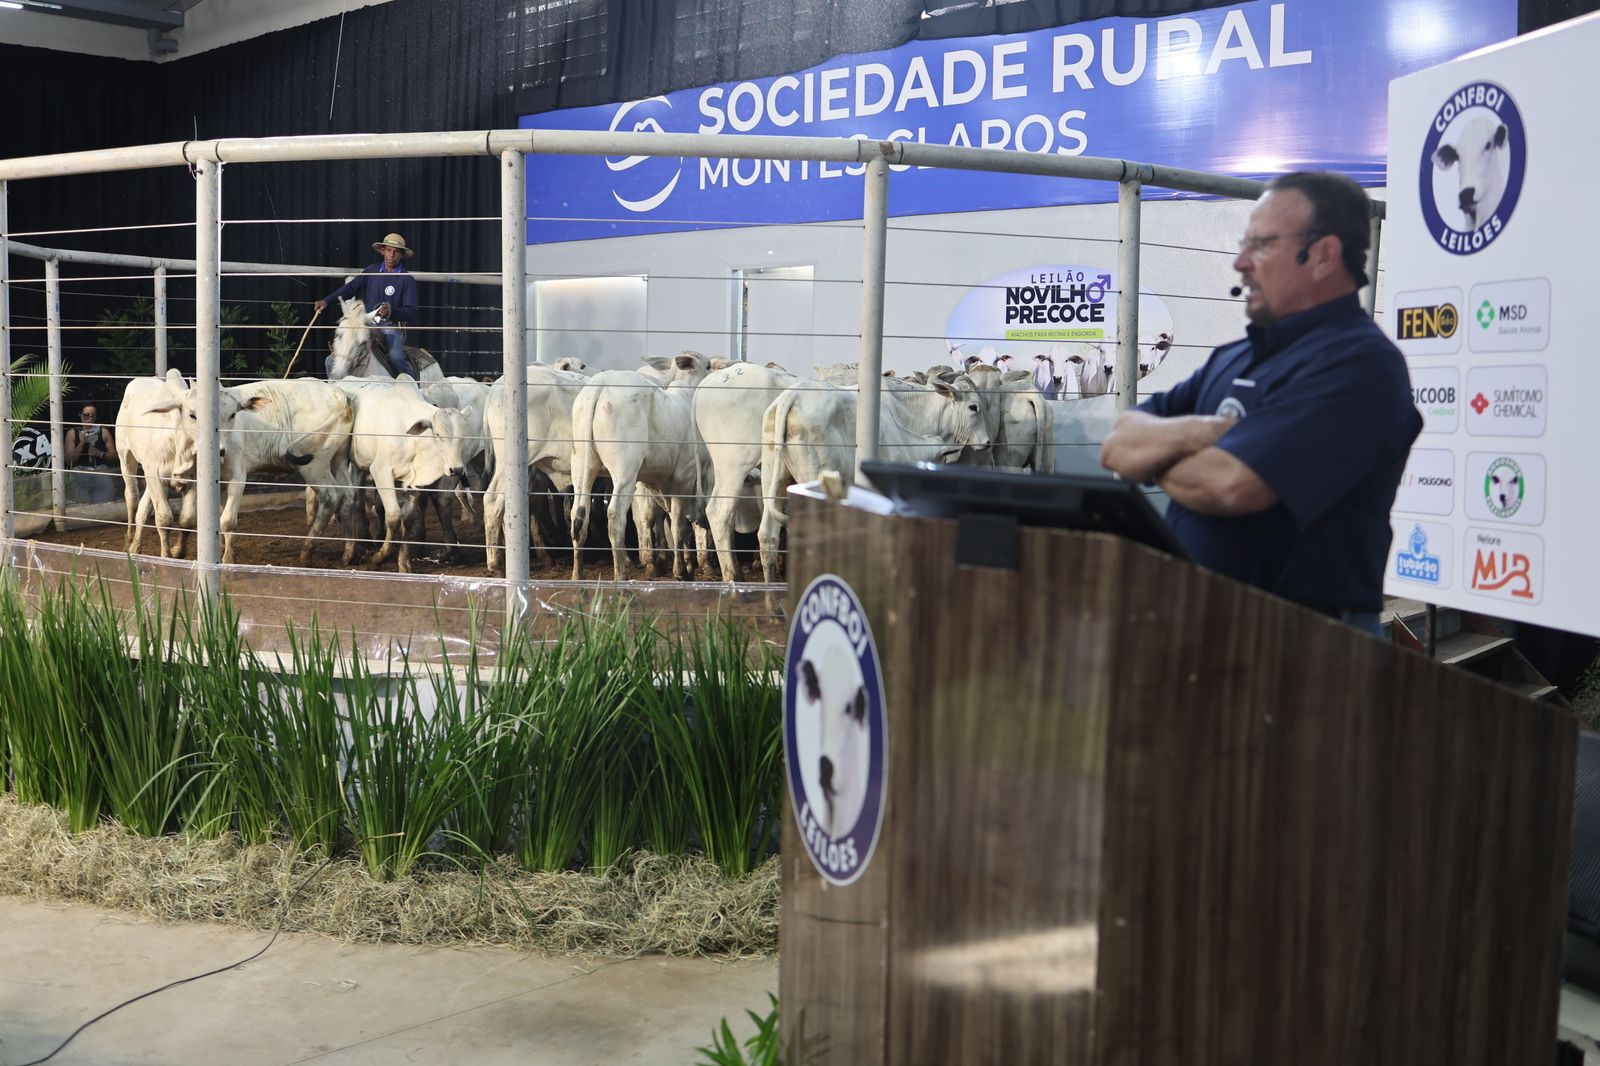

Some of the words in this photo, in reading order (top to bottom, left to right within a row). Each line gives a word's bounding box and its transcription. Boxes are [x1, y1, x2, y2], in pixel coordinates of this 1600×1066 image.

[698, 40, 1028, 135] SOCIEDADE
[1052, 3, 1313, 93] RURAL
[1435, 85, 1505, 133] CONFBOI
[1031, 270, 1084, 284] LEILÃO
[1005, 303, 1105, 324] PRECOCE
[1499, 304, 1527, 321] MSD
[1493, 404, 1537, 418] CHEMICAL
[1477, 534, 1501, 546] Nelore
[801, 585, 868, 658] CONFBOI
